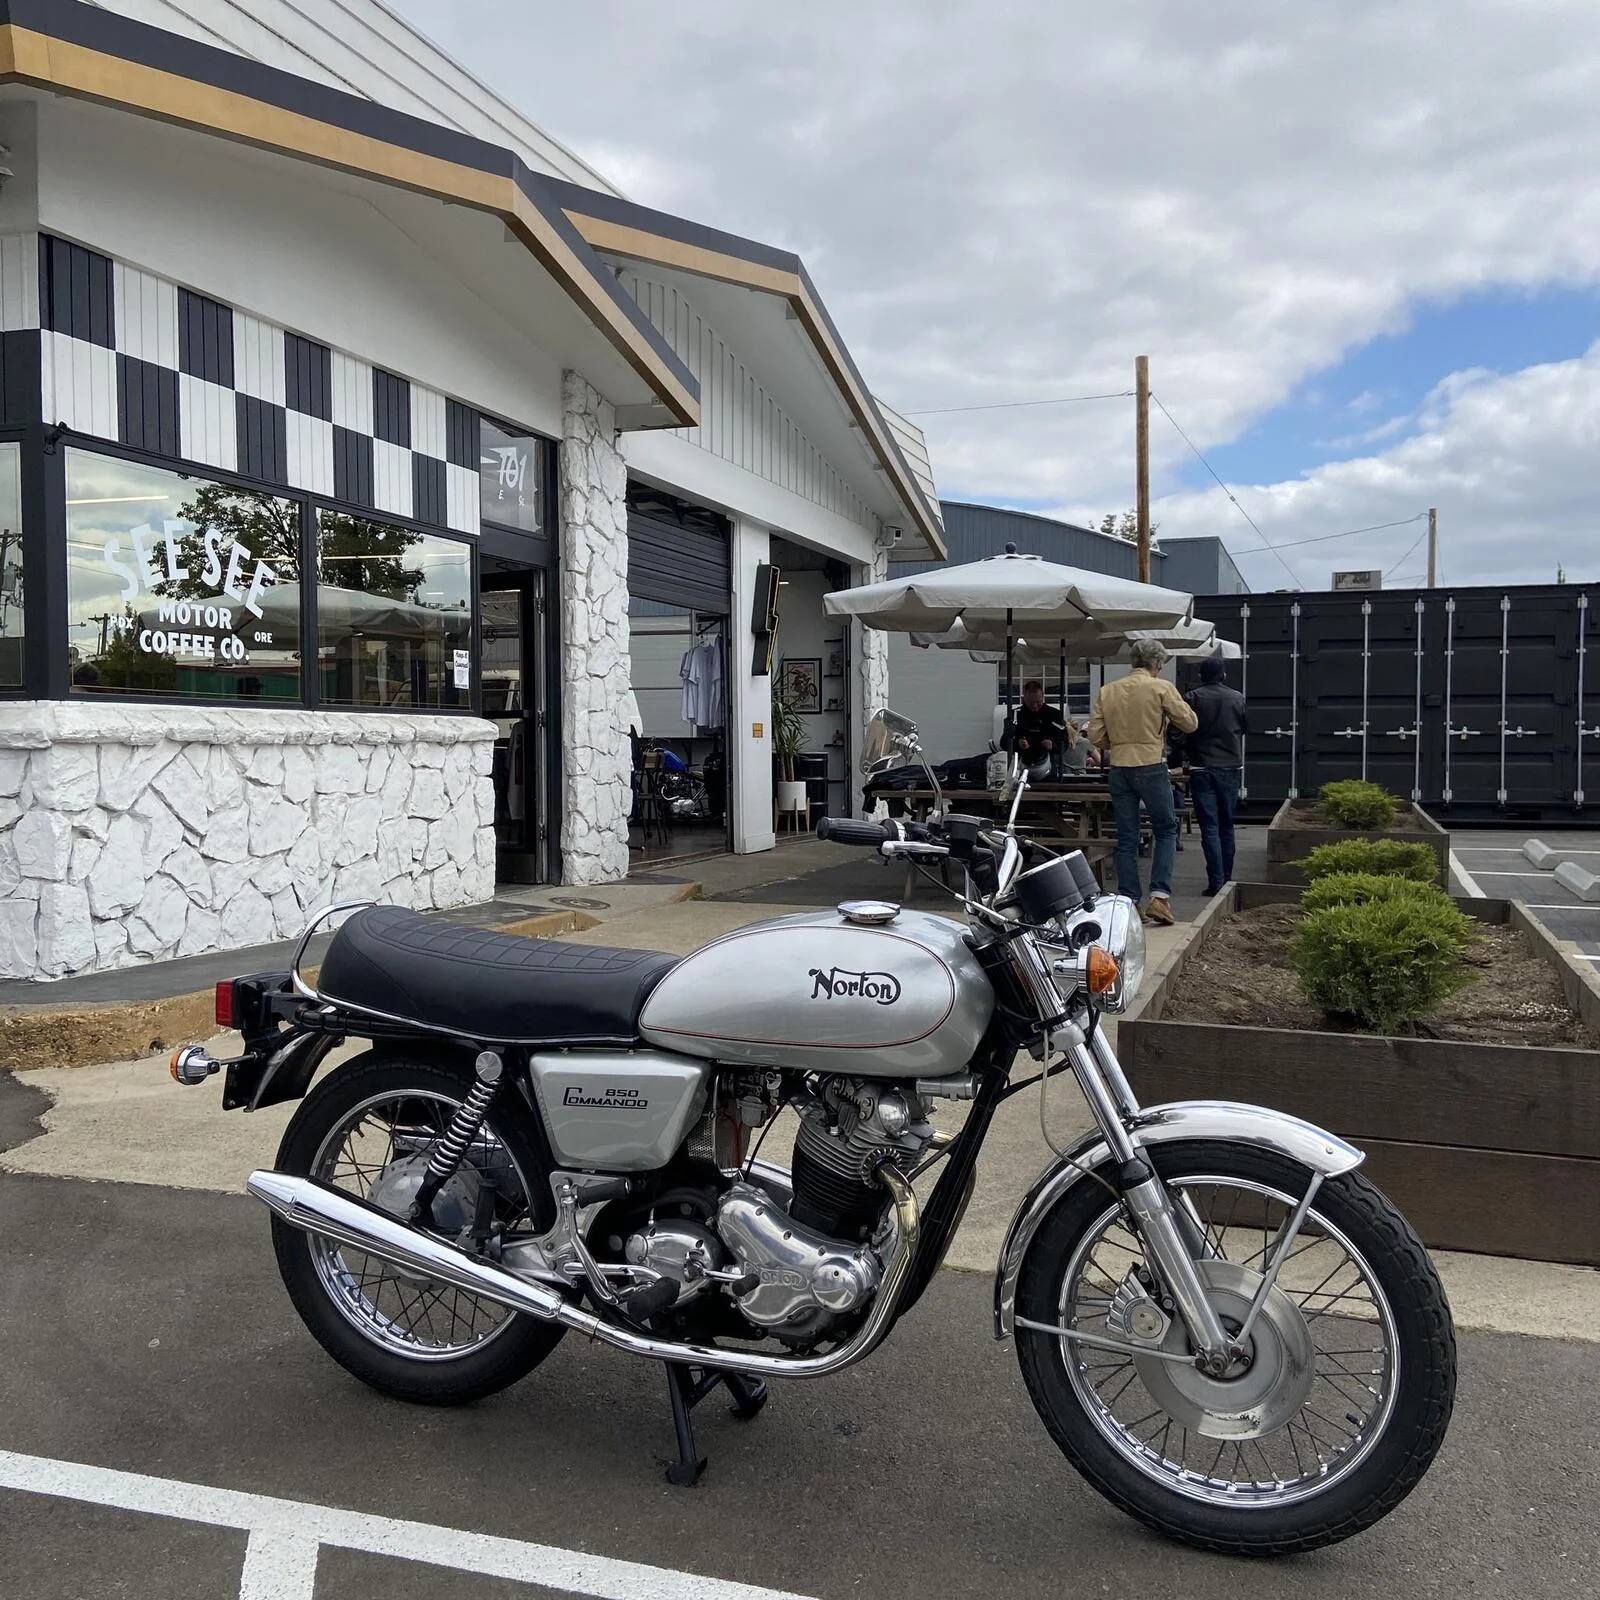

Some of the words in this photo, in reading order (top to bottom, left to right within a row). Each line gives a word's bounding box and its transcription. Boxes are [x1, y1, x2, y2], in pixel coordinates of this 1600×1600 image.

[103, 519, 190, 602] SEE
[201, 522, 276, 620] SEE
[108, 614, 134, 630] PDX
[158, 602, 233, 630] MOTOR
[139, 629, 216, 658] COFFEE
[220, 636, 251, 661] CO.
[254, 631, 273, 644] ORE
[808, 966, 902, 1005] Norton
[563, 1087, 649, 1110] COMMANDO
[605, 1088, 639, 1098] 850
